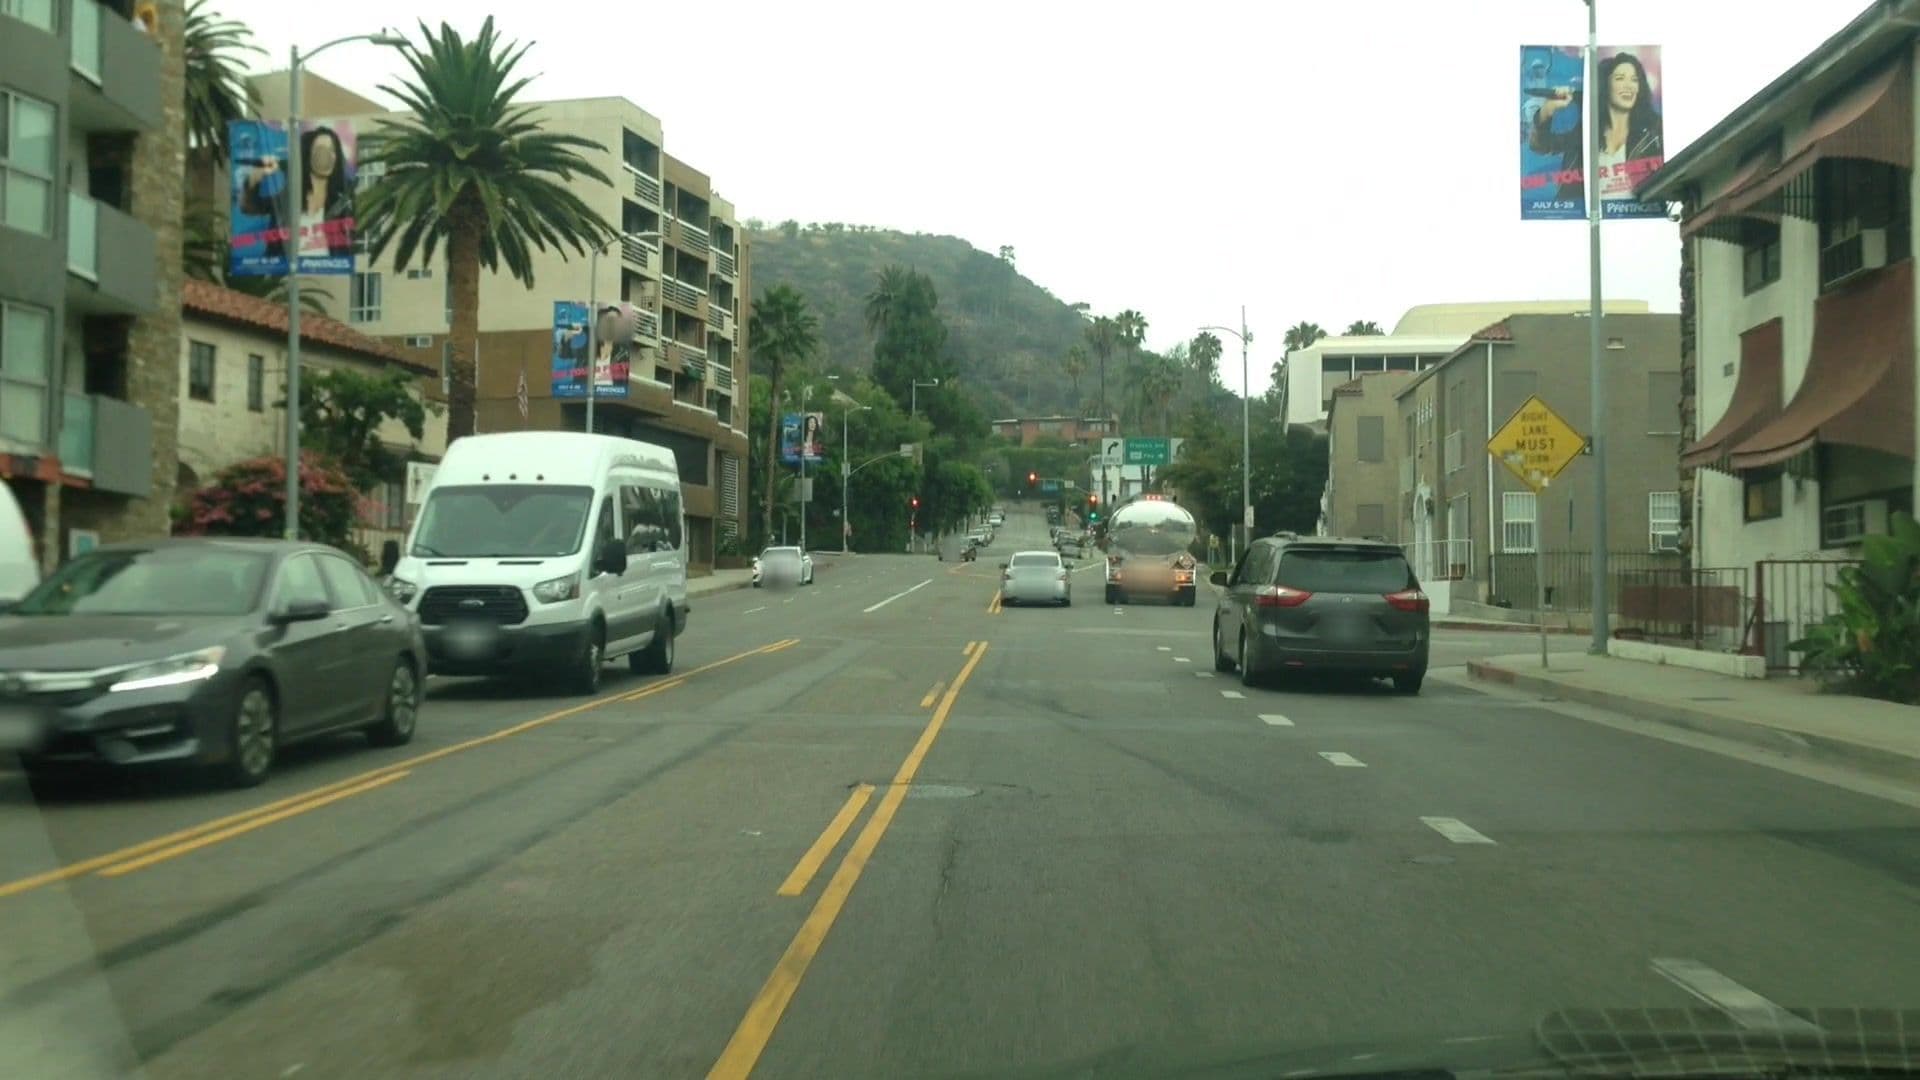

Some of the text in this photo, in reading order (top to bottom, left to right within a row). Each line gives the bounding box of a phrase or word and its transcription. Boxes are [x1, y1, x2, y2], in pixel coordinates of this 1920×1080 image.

[1521, 412, 1548, 421] RIGHT
[1522, 425, 1548, 435] LANE
[1516, 438, 1555, 451] MUST
